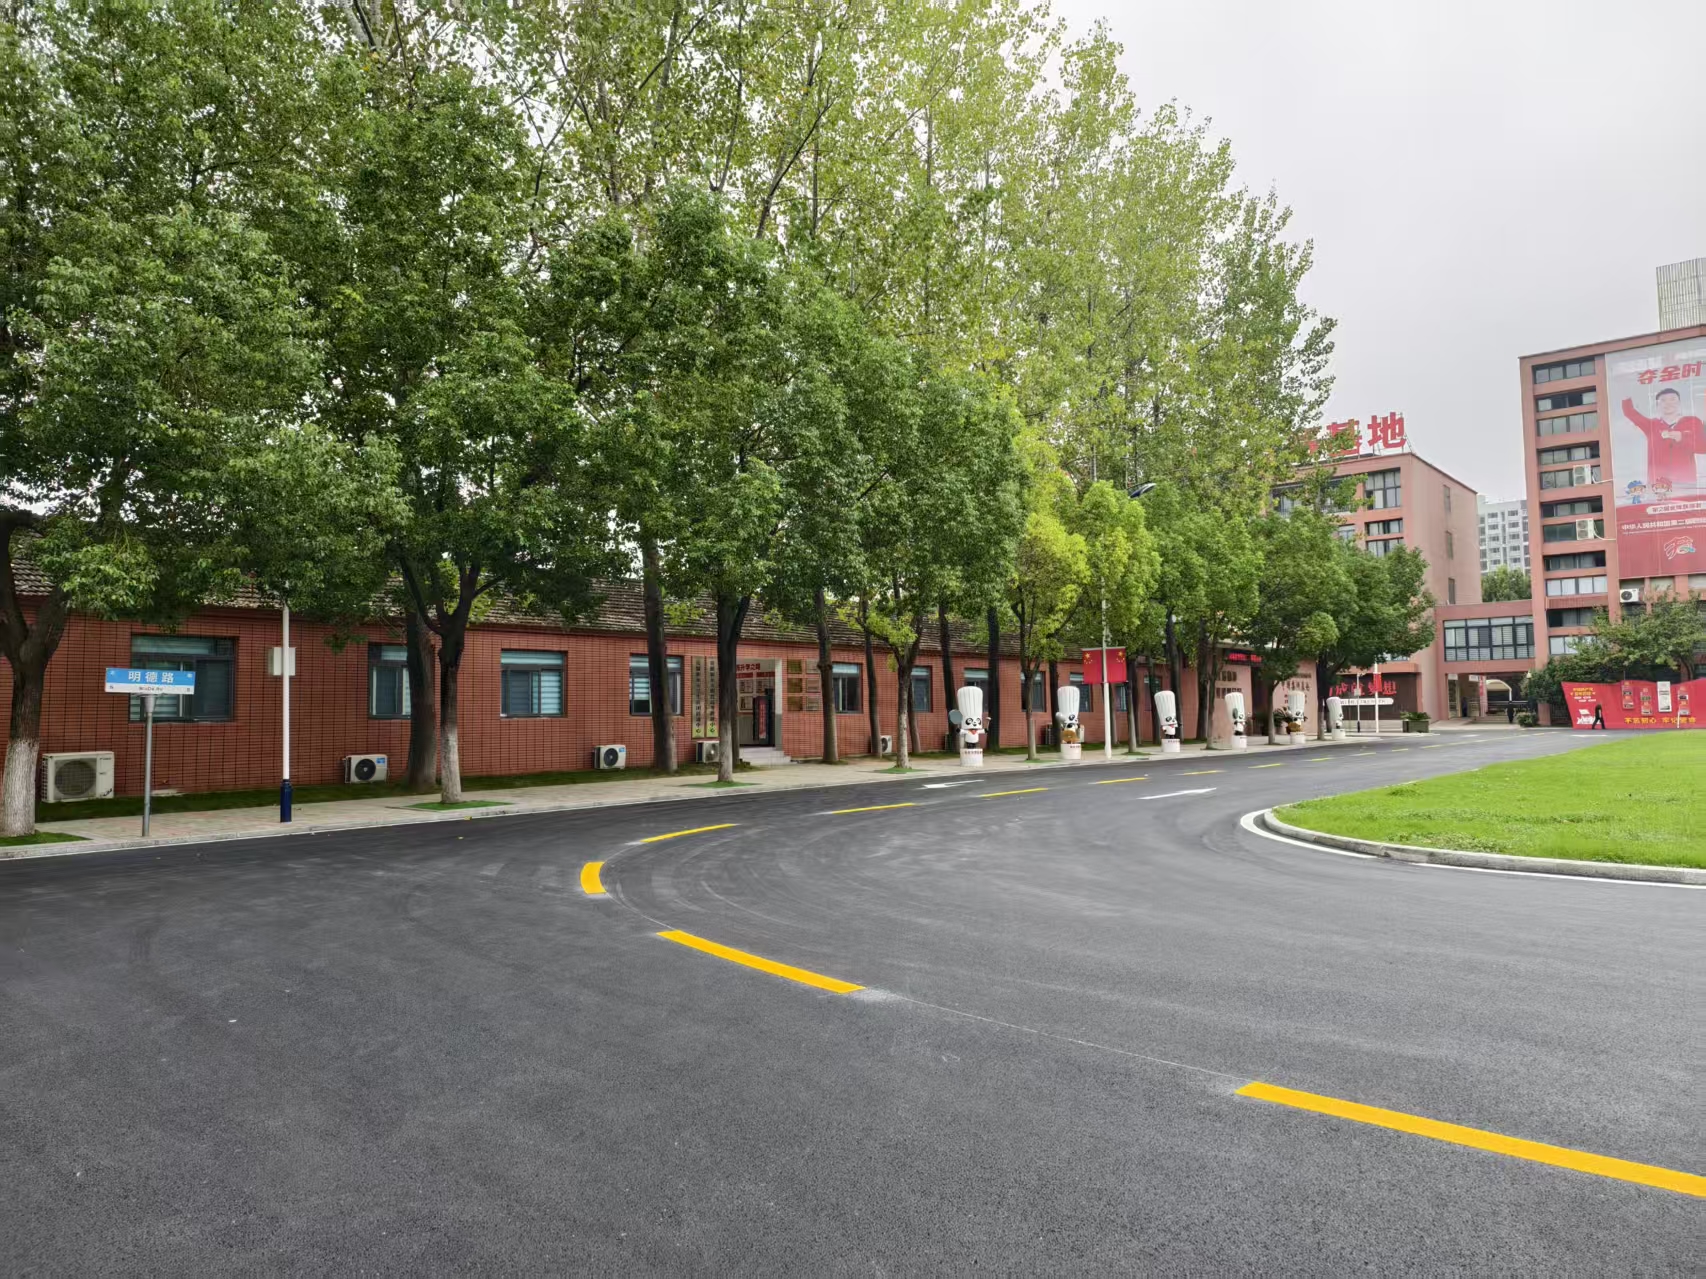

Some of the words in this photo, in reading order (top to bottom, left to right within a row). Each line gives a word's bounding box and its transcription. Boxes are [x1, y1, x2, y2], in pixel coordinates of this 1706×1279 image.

[128, 671, 174, 683] 明德路
[1624, 717, 1657, 725] 不忘初心
